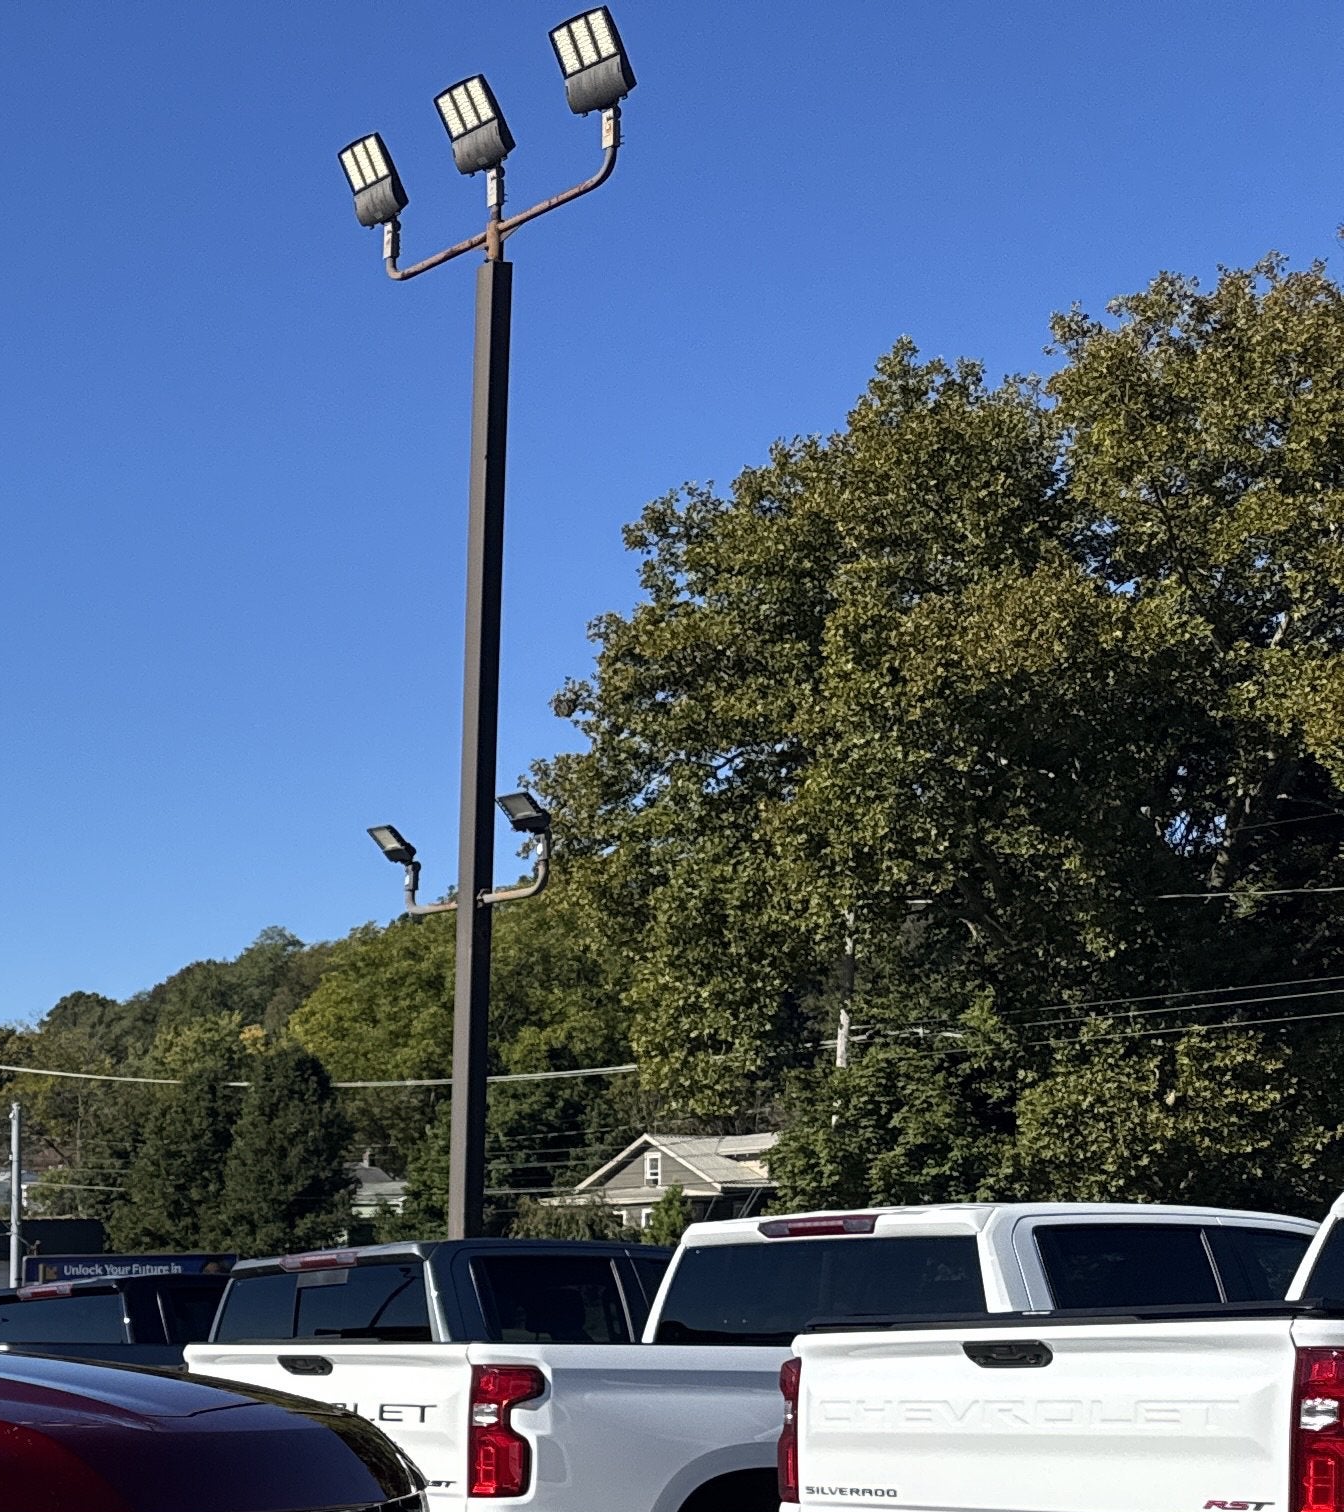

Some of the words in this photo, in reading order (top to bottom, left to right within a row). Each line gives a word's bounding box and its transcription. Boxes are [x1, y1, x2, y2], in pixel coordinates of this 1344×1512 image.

[63, 1263, 103, 1275] Unlock
[104, 1263, 130, 1276] Your
[132, 1263, 169, 1276] Future
[817, 1398, 1241, 1431] CHEVROLET
[805, 1485, 898, 1498] SILVERADO
[1203, 1499, 1276, 1512] RST
